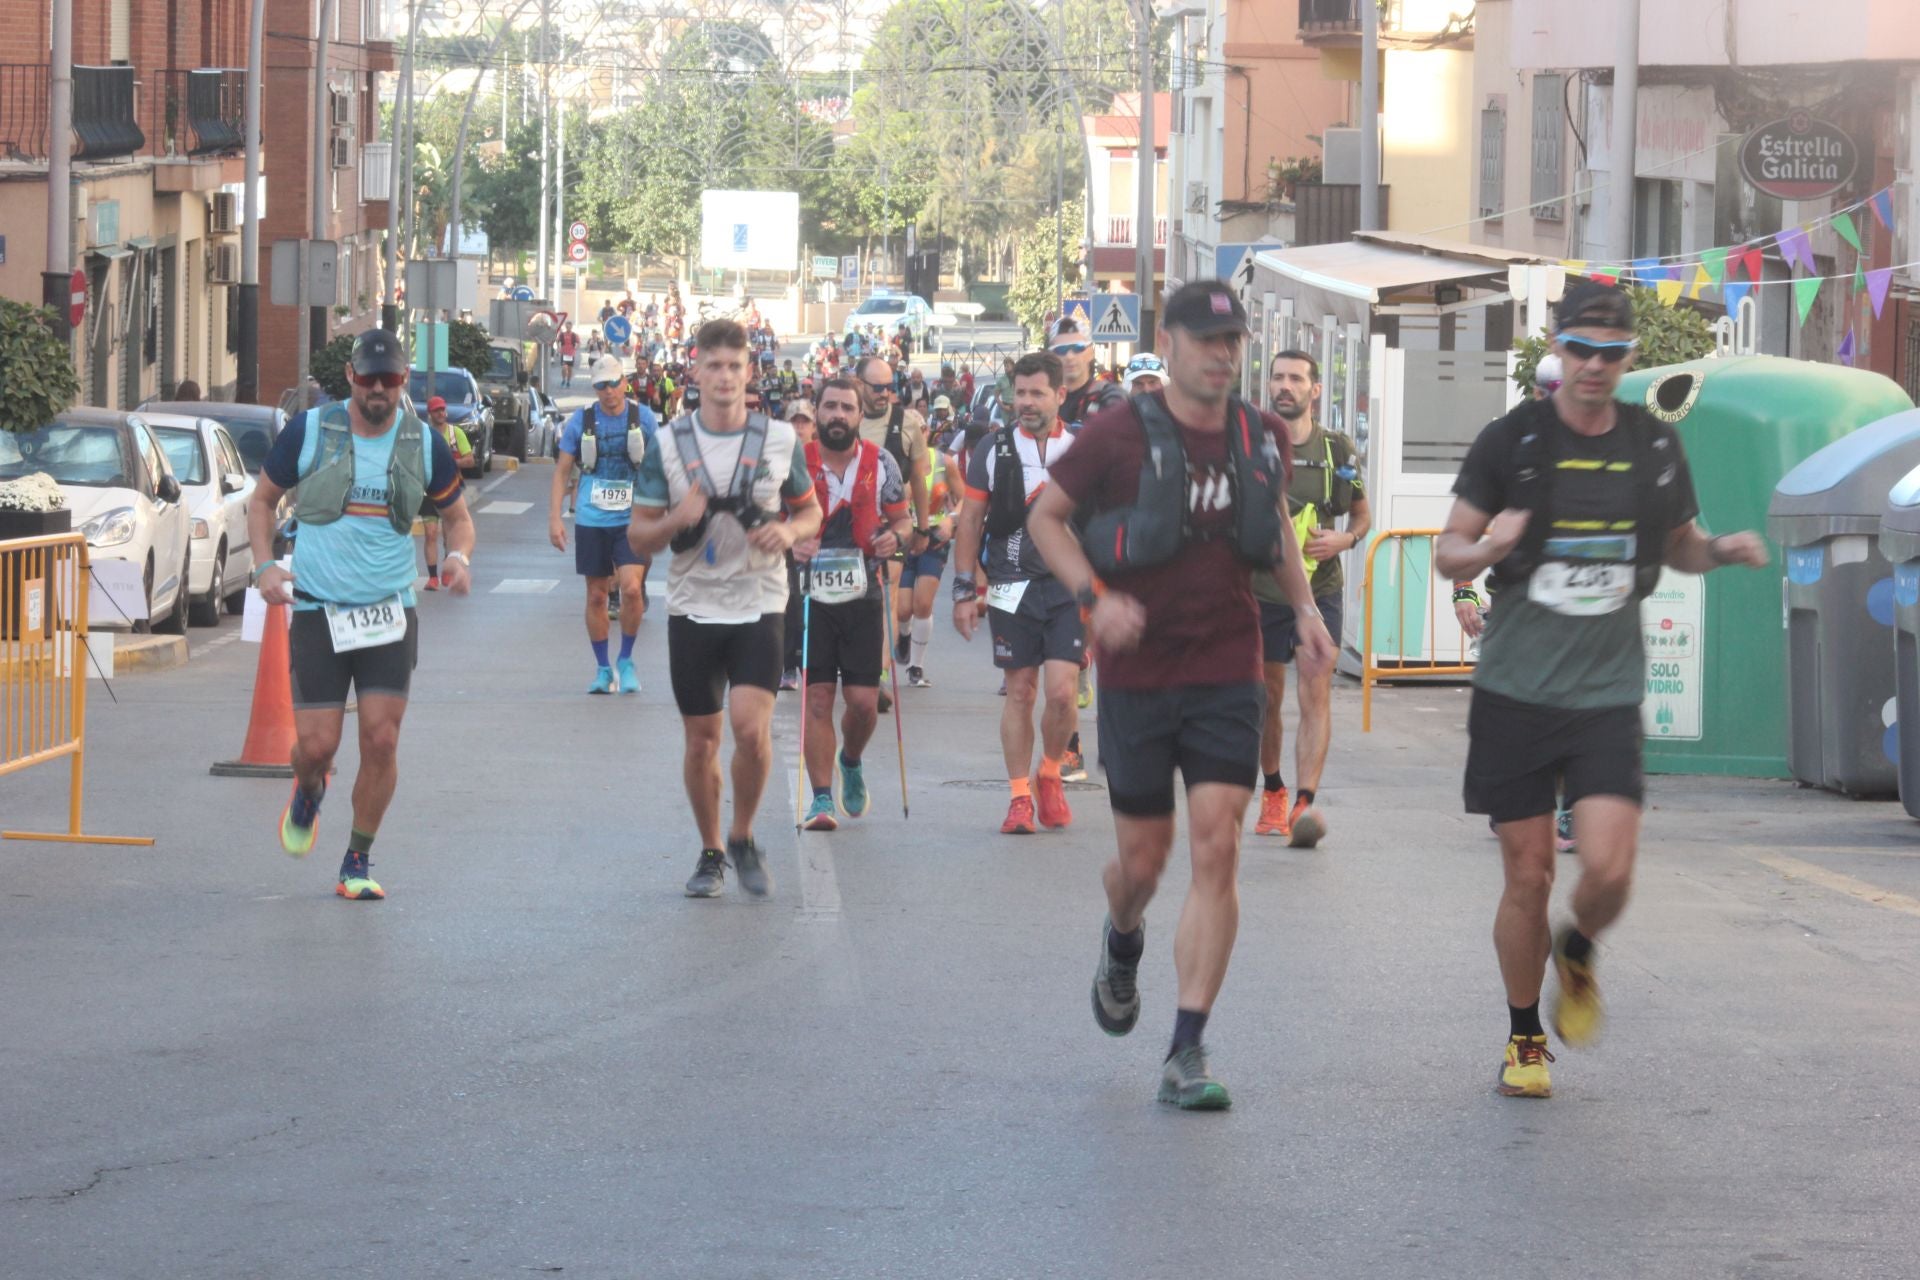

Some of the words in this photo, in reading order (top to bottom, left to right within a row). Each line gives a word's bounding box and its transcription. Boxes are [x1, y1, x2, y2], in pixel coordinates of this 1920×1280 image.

[1759, 135, 1842, 156] Estrella
[1762, 157, 1838, 179] Galicia
[575, 228, 585, 236] 30
[1661, 402, 1691, 421] VIDRIO
[601, 489, 627, 500] 1979
[815, 570, 854, 587] 1514
[347, 605, 394, 629] 1328
[1651, 663, 1680, 677] SOLO
[1647, 680, 1684, 694] VIDRIO
